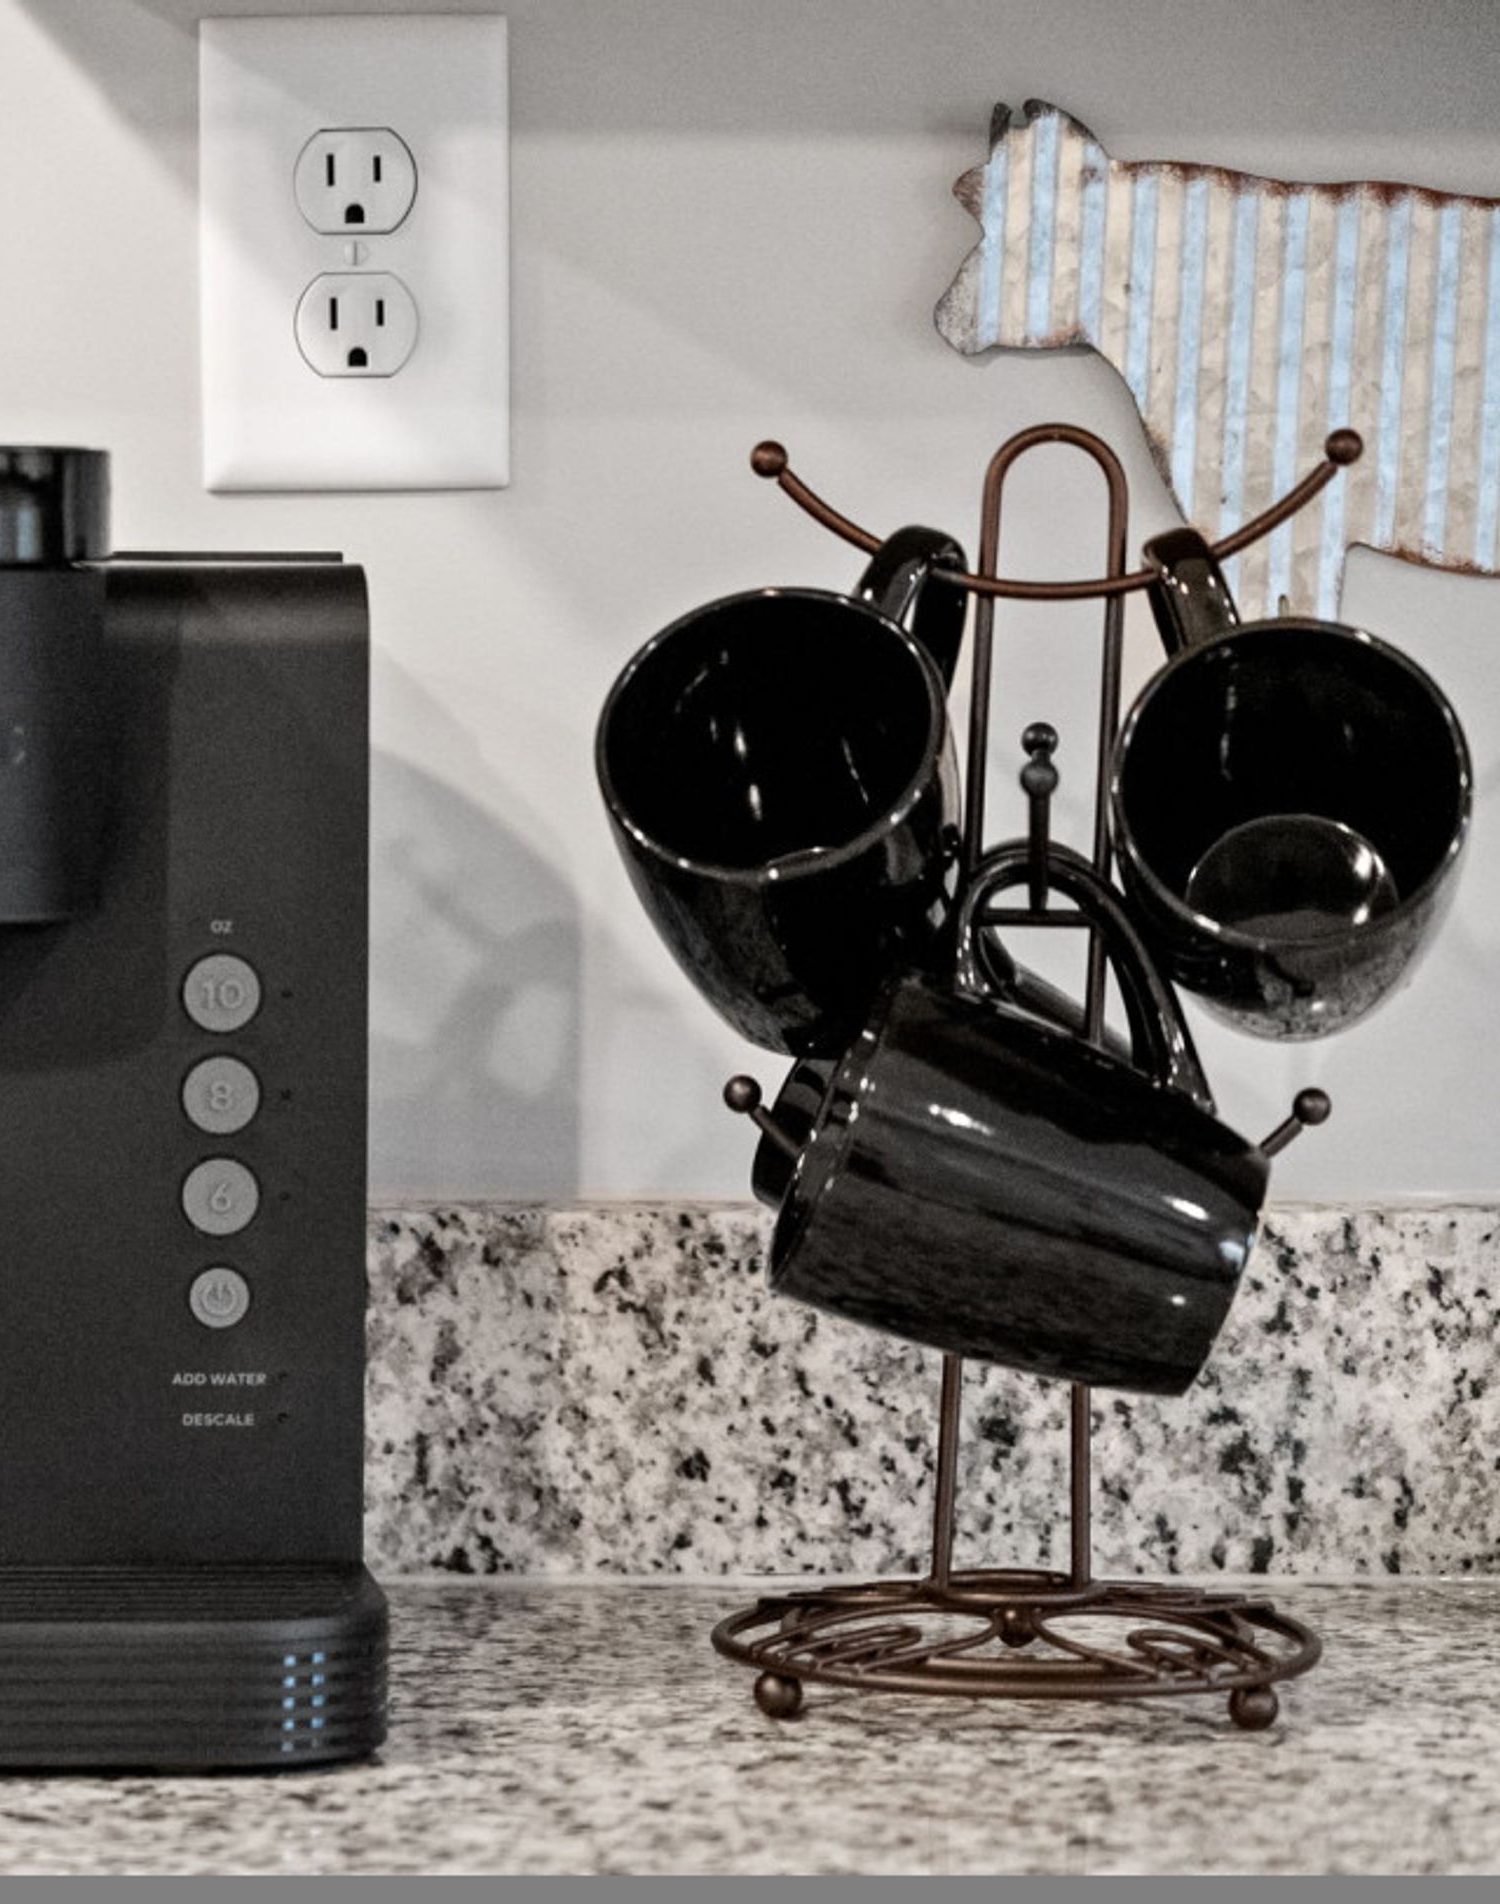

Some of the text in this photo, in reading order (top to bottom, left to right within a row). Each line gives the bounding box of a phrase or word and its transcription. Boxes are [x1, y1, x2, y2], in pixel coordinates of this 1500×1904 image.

[203, 978, 246, 1009] 10
[211, 1183, 232, 1213] 6
[172, 1373, 267, 1386] ADD WATER
[182, 1413, 255, 1427] DESCALE
